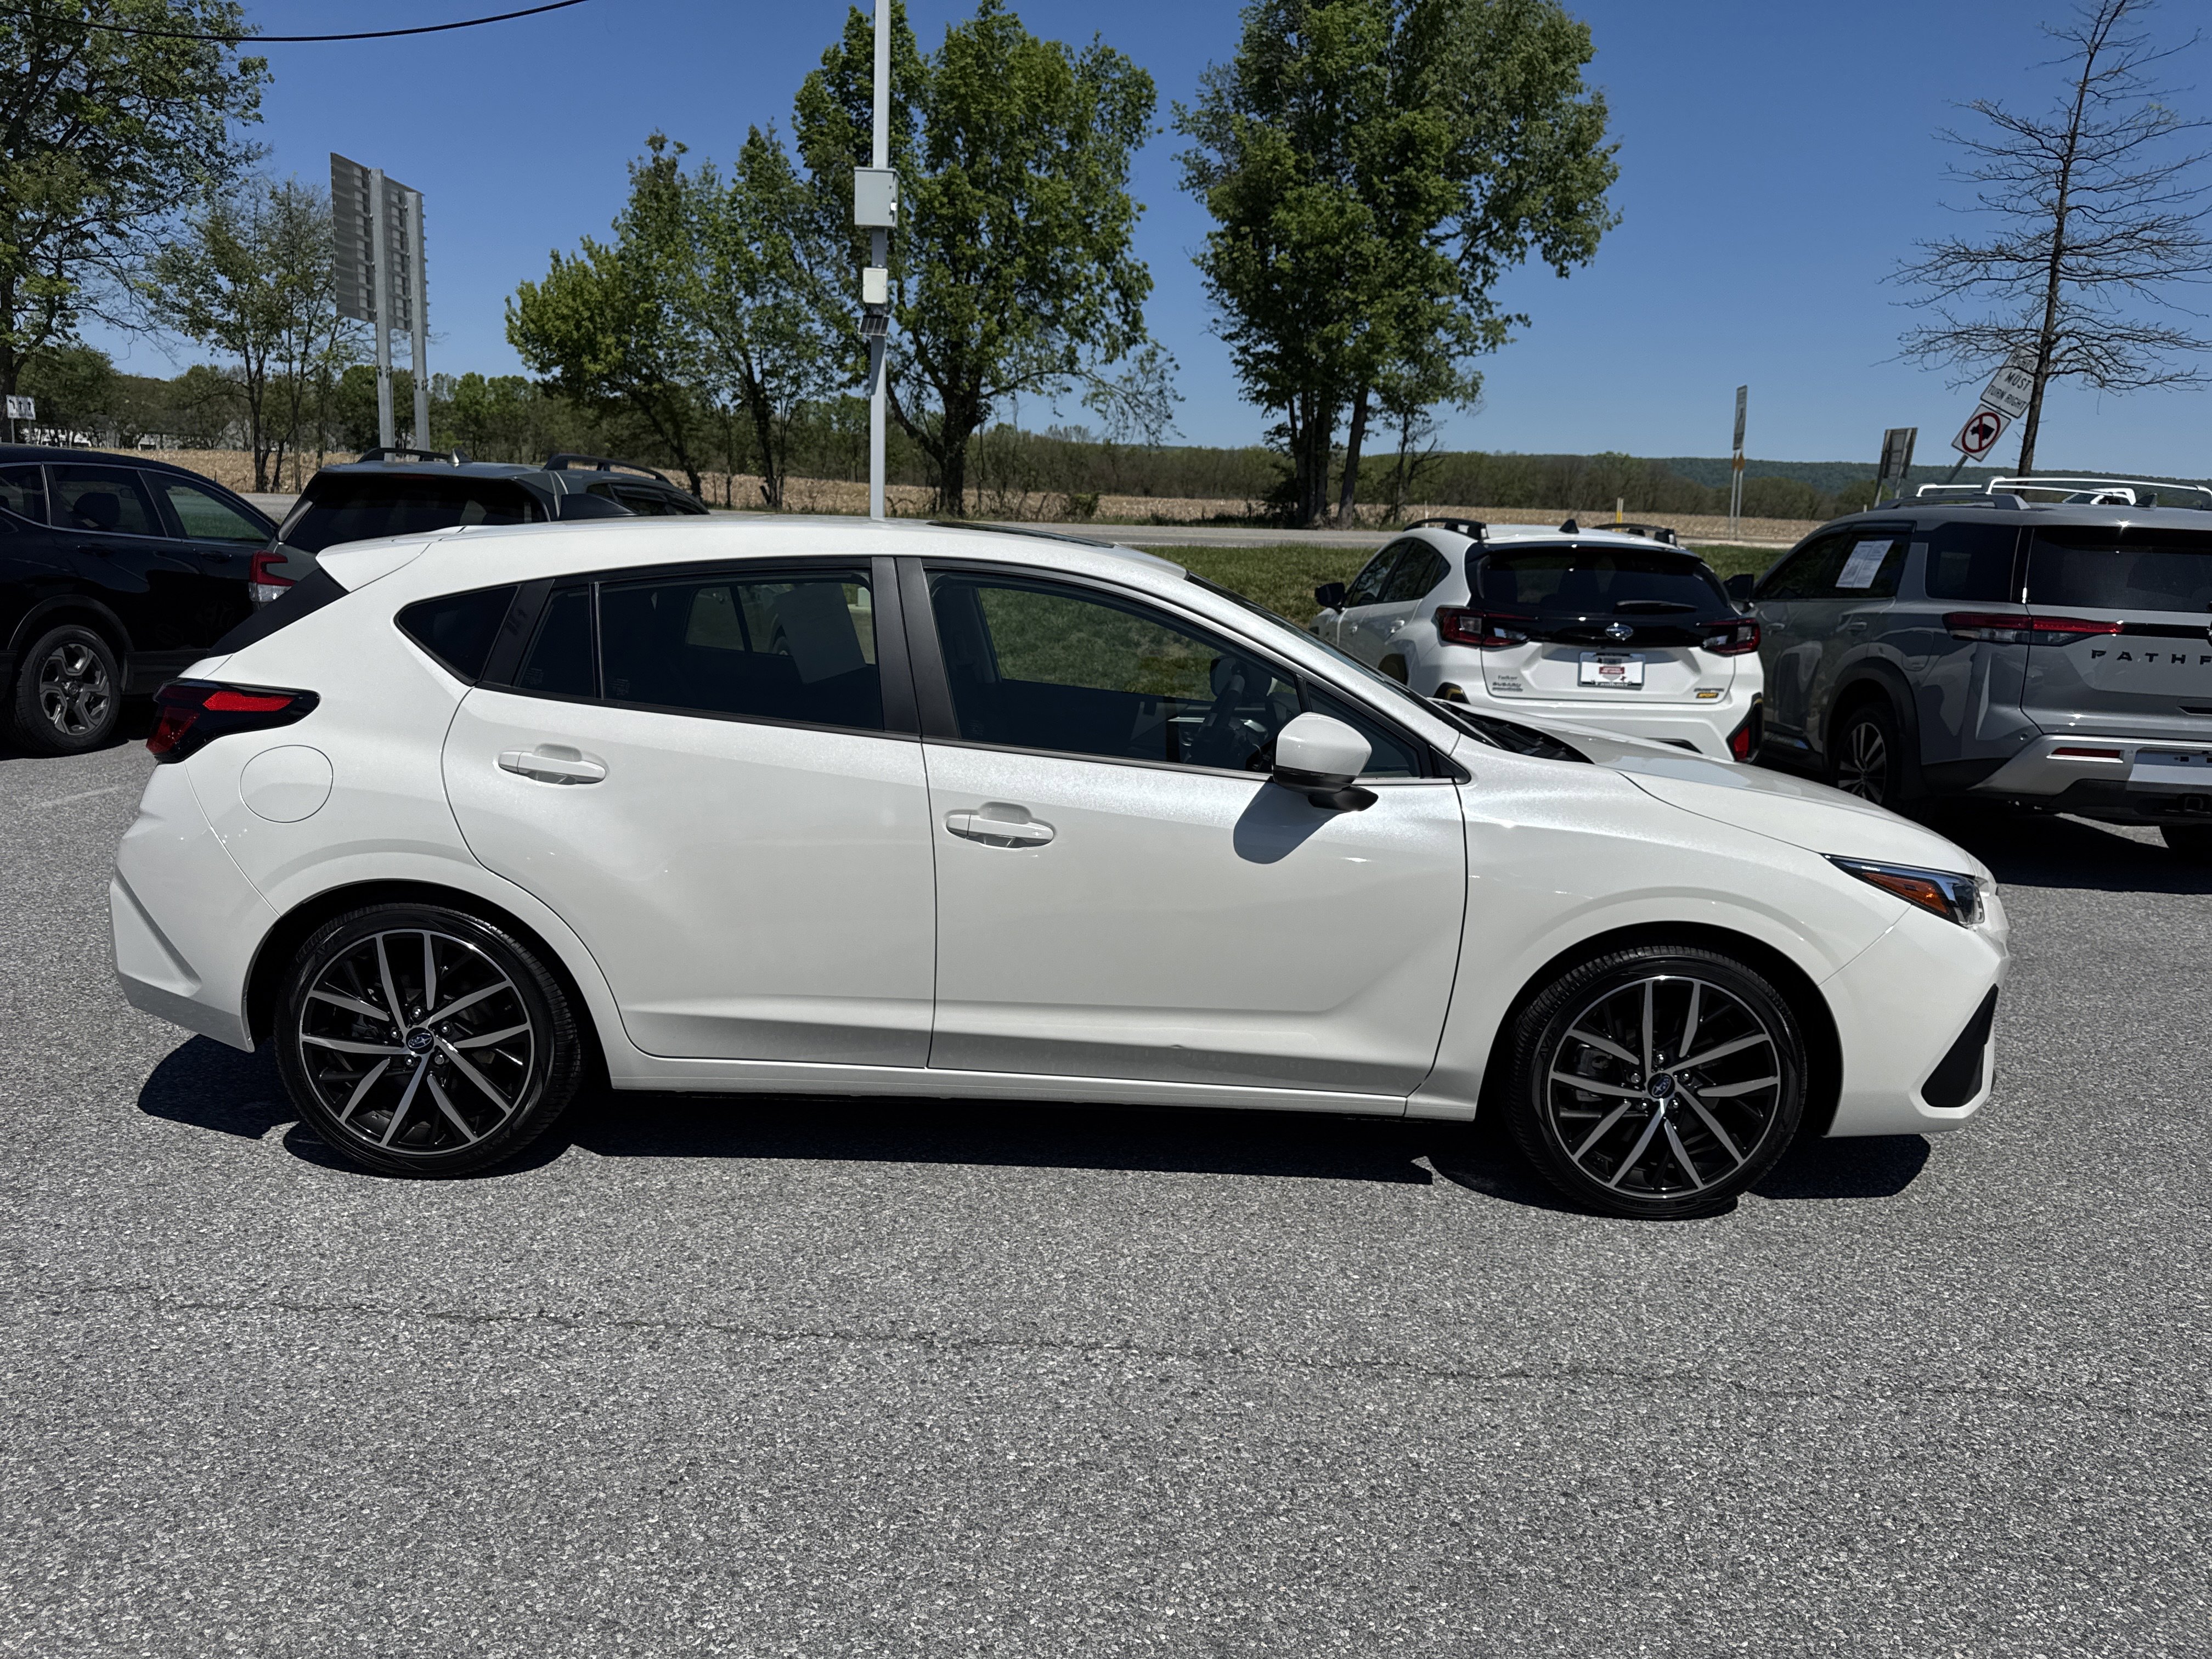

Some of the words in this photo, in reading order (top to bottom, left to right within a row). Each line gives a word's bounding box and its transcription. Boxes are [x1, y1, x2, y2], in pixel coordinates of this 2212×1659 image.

[2004, 371, 2032, 391] MUST
[1987, 385, 2007, 400] TURN
[2091, 649, 2212, 665] PATHF
